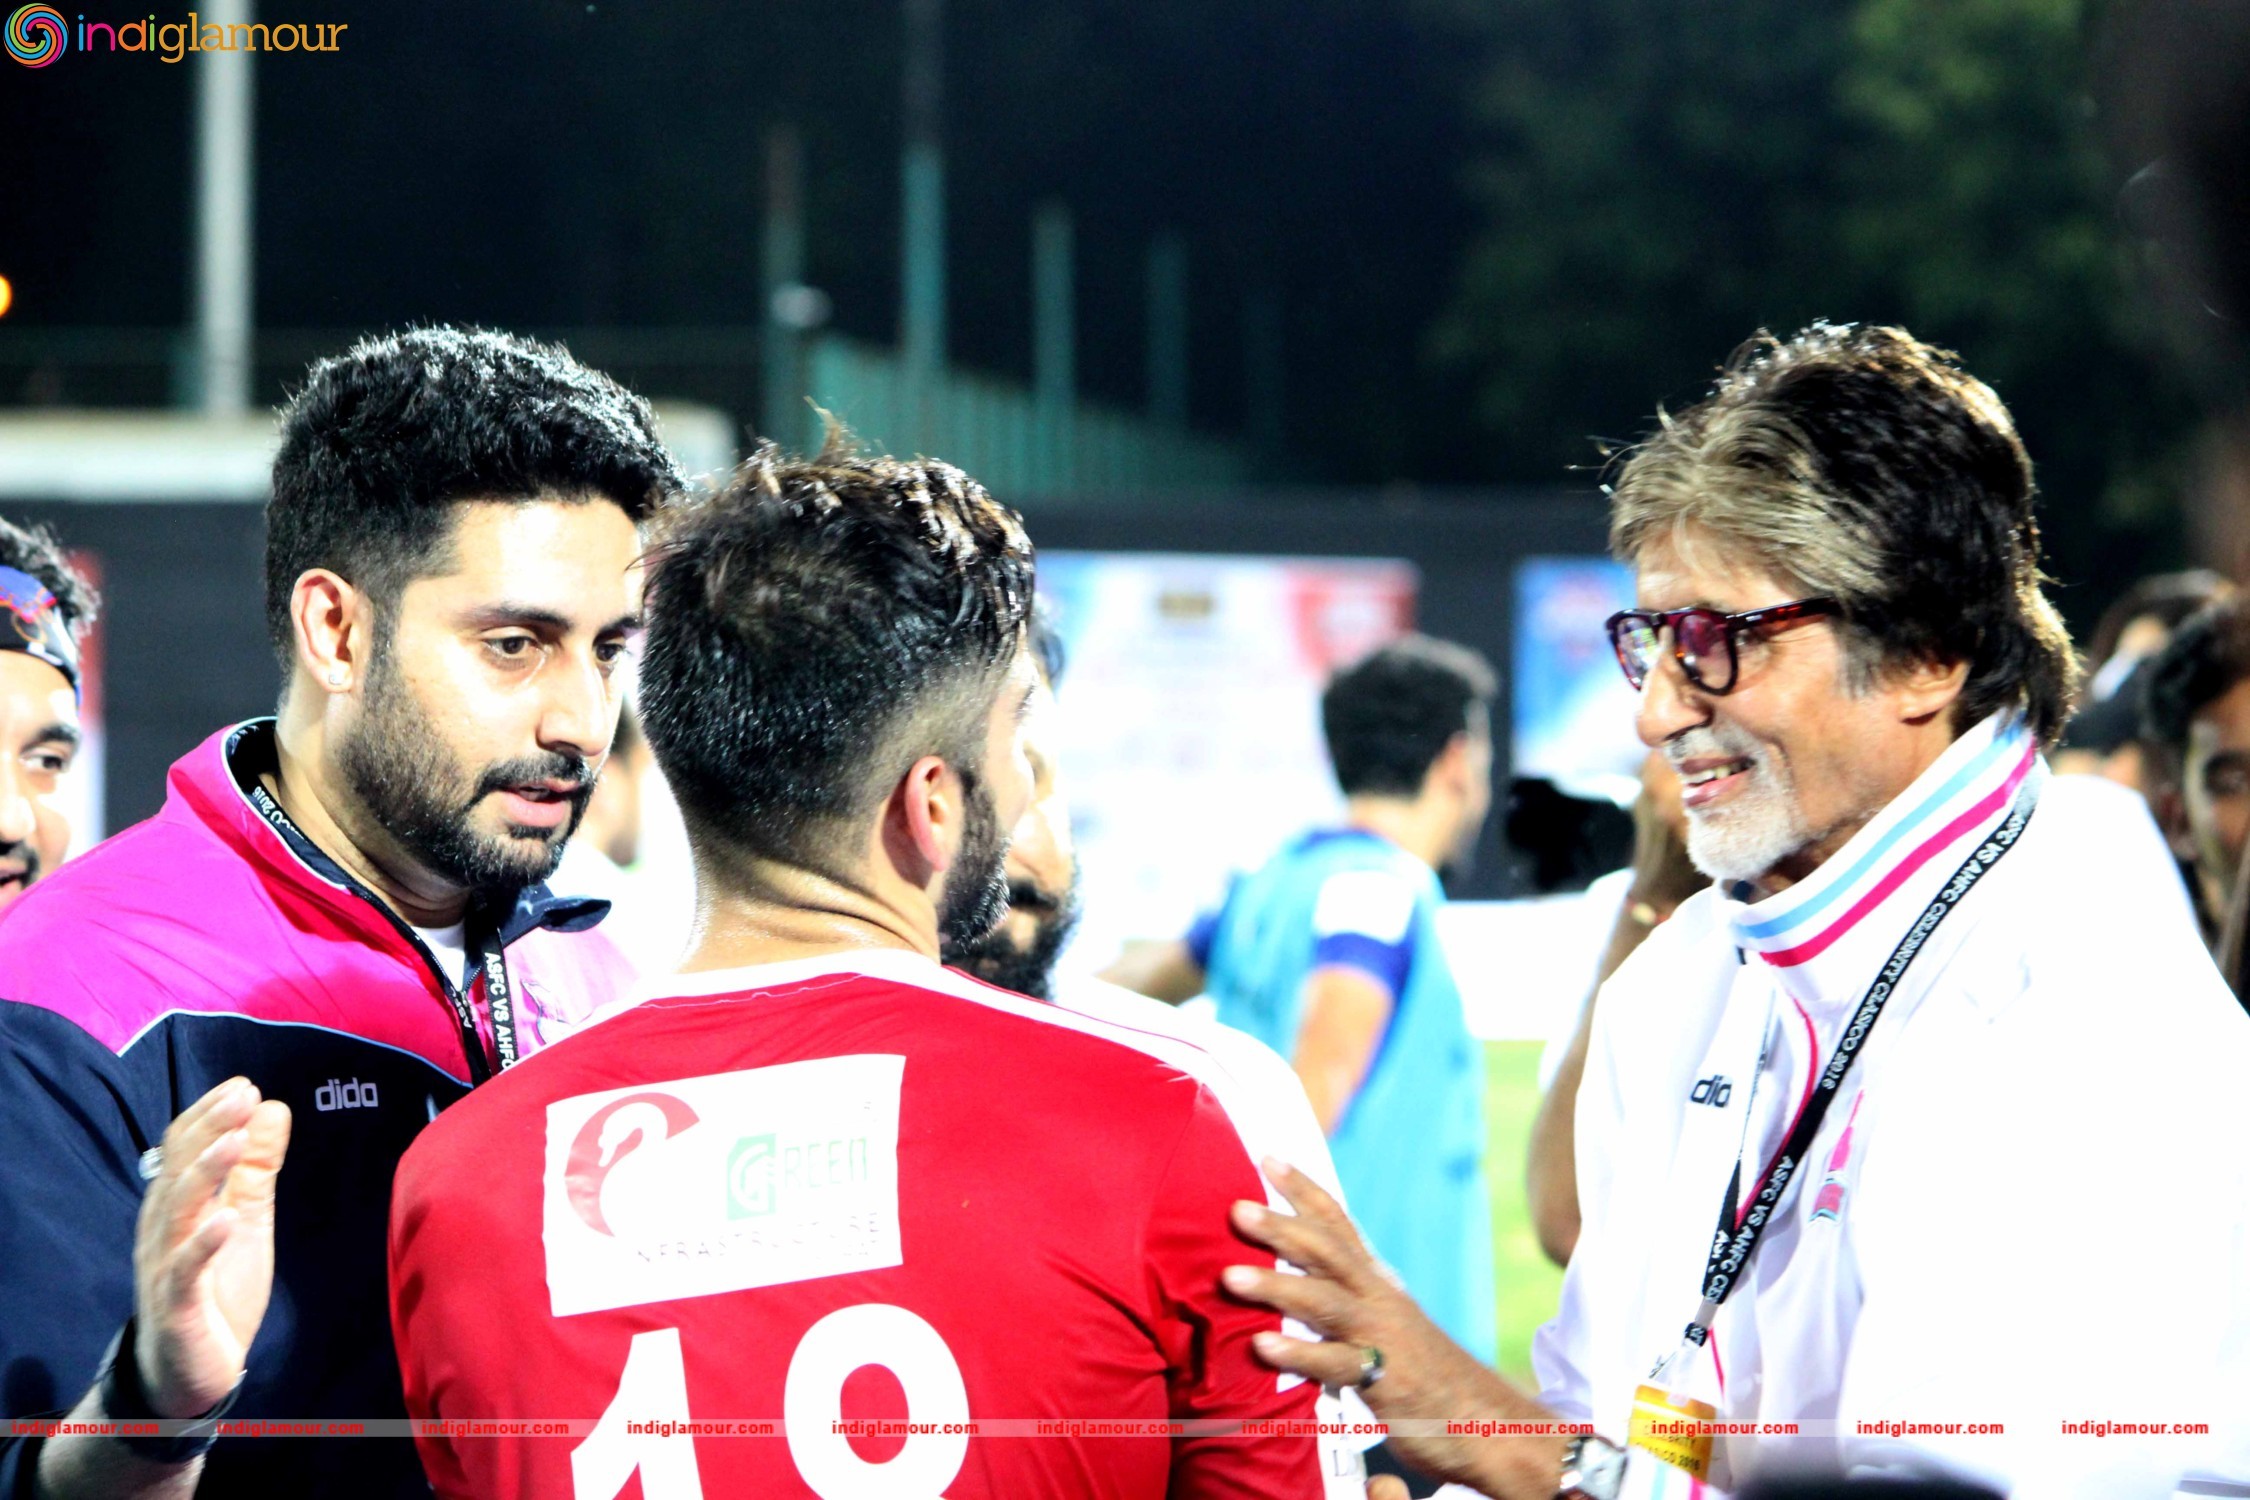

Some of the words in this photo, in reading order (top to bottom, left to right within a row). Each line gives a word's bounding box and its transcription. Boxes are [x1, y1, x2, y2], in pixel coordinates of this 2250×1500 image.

[485, 952, 506, 996] ASFC
[492, 998, 510, 1022] VS
[1747, 1204, 1770, 1227] VS
